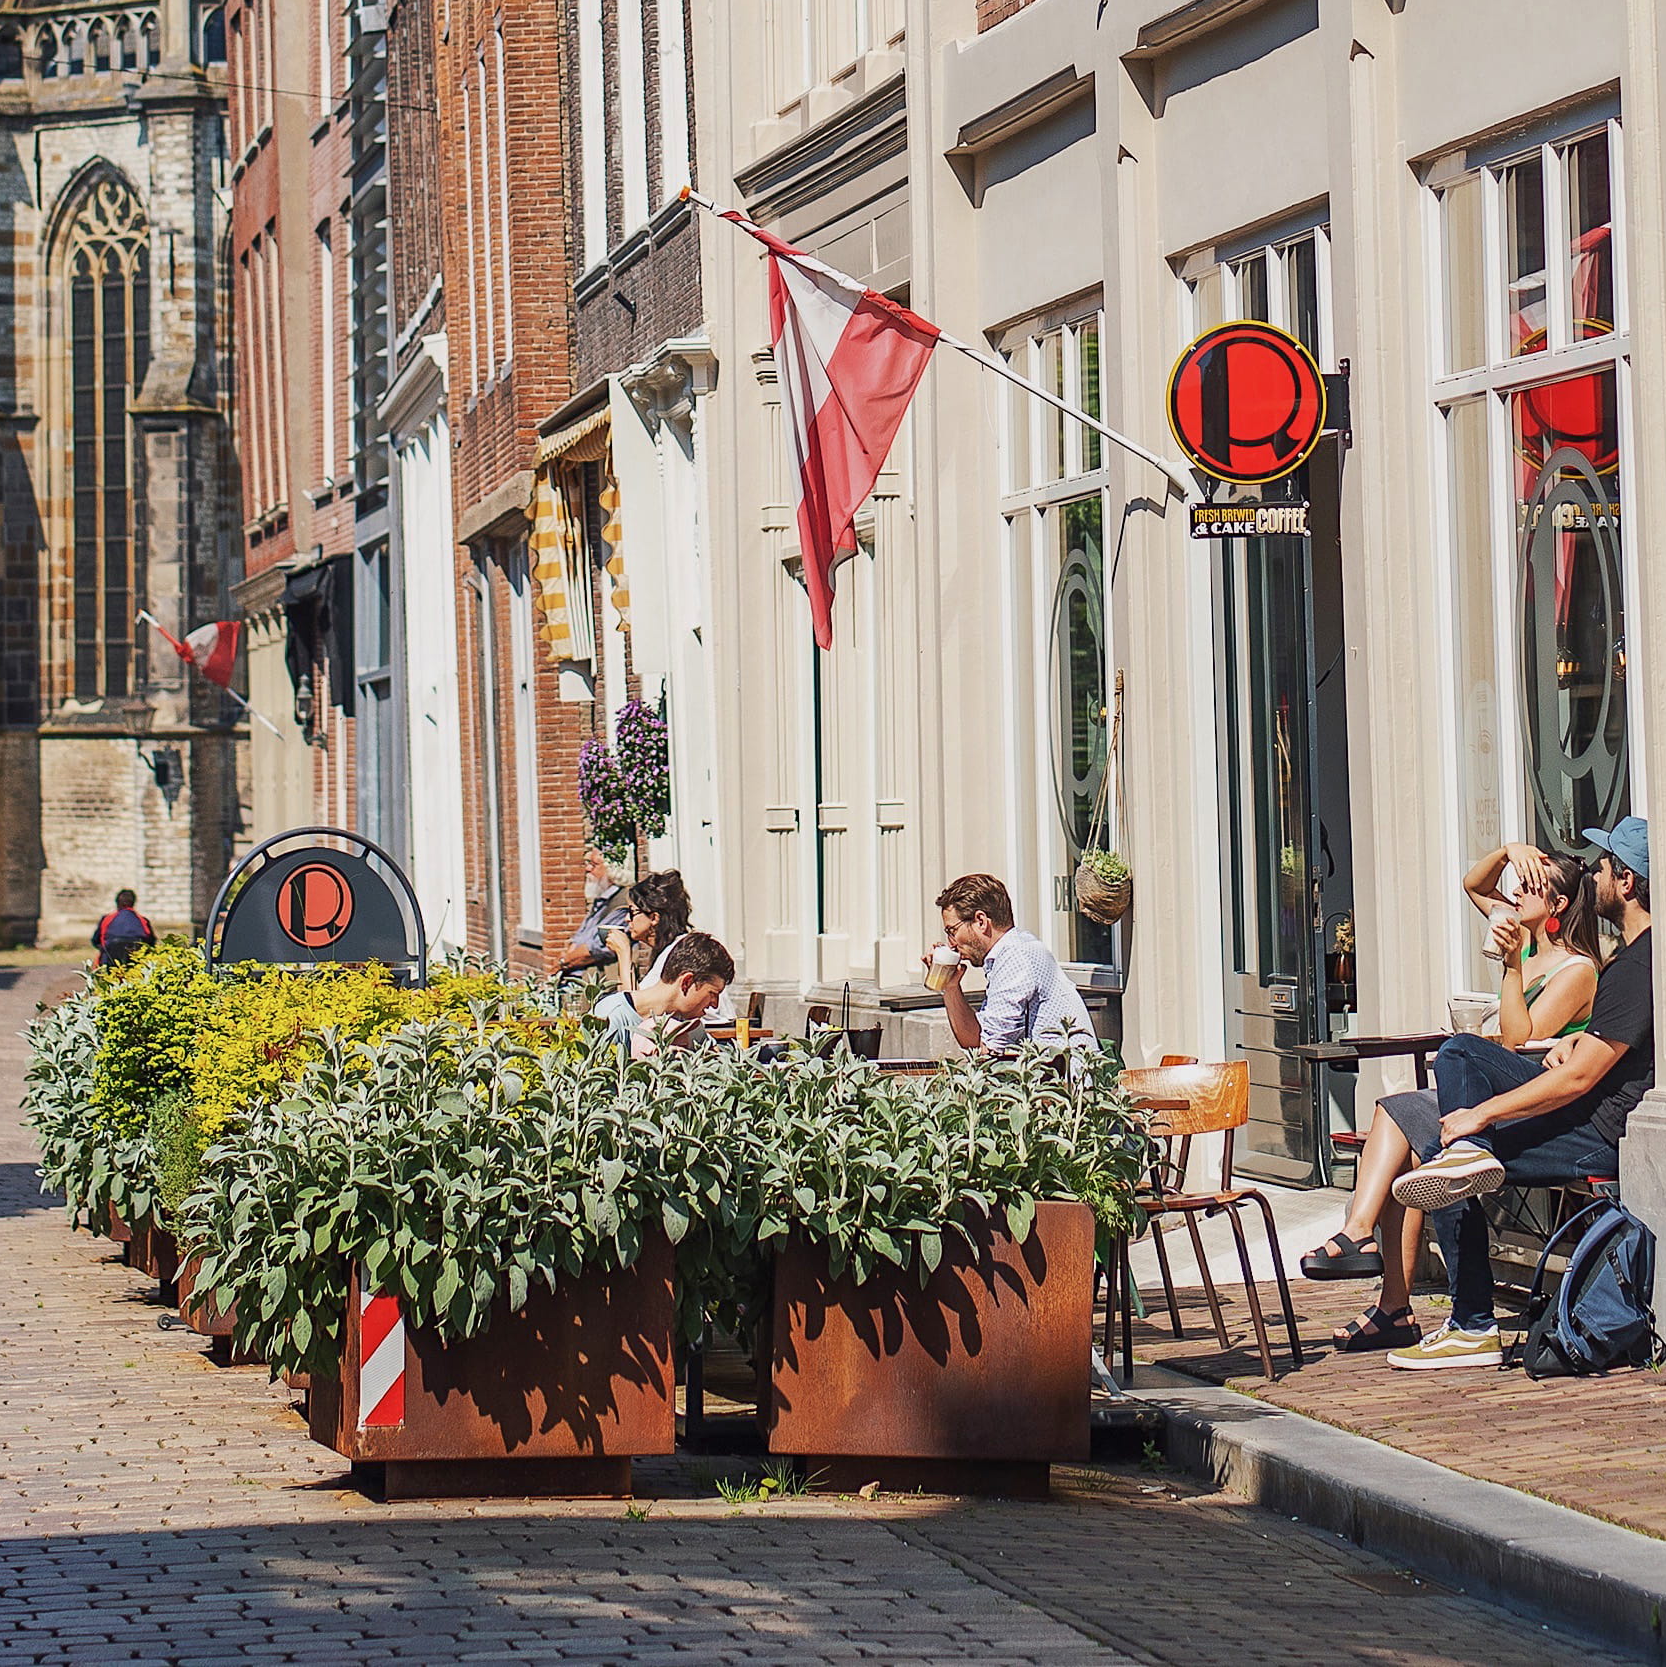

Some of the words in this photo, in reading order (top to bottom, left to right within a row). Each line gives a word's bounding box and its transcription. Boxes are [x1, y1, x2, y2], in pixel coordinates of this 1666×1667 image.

[1194, 508, 1221, 523] FRESH
[1221, 508, 1256, 522] BREWED
[1255, 507, 1307, 534] COFFEE
[1195, 522, 1209, 535] &
[1210, 522, 1255, 534] CAKE
